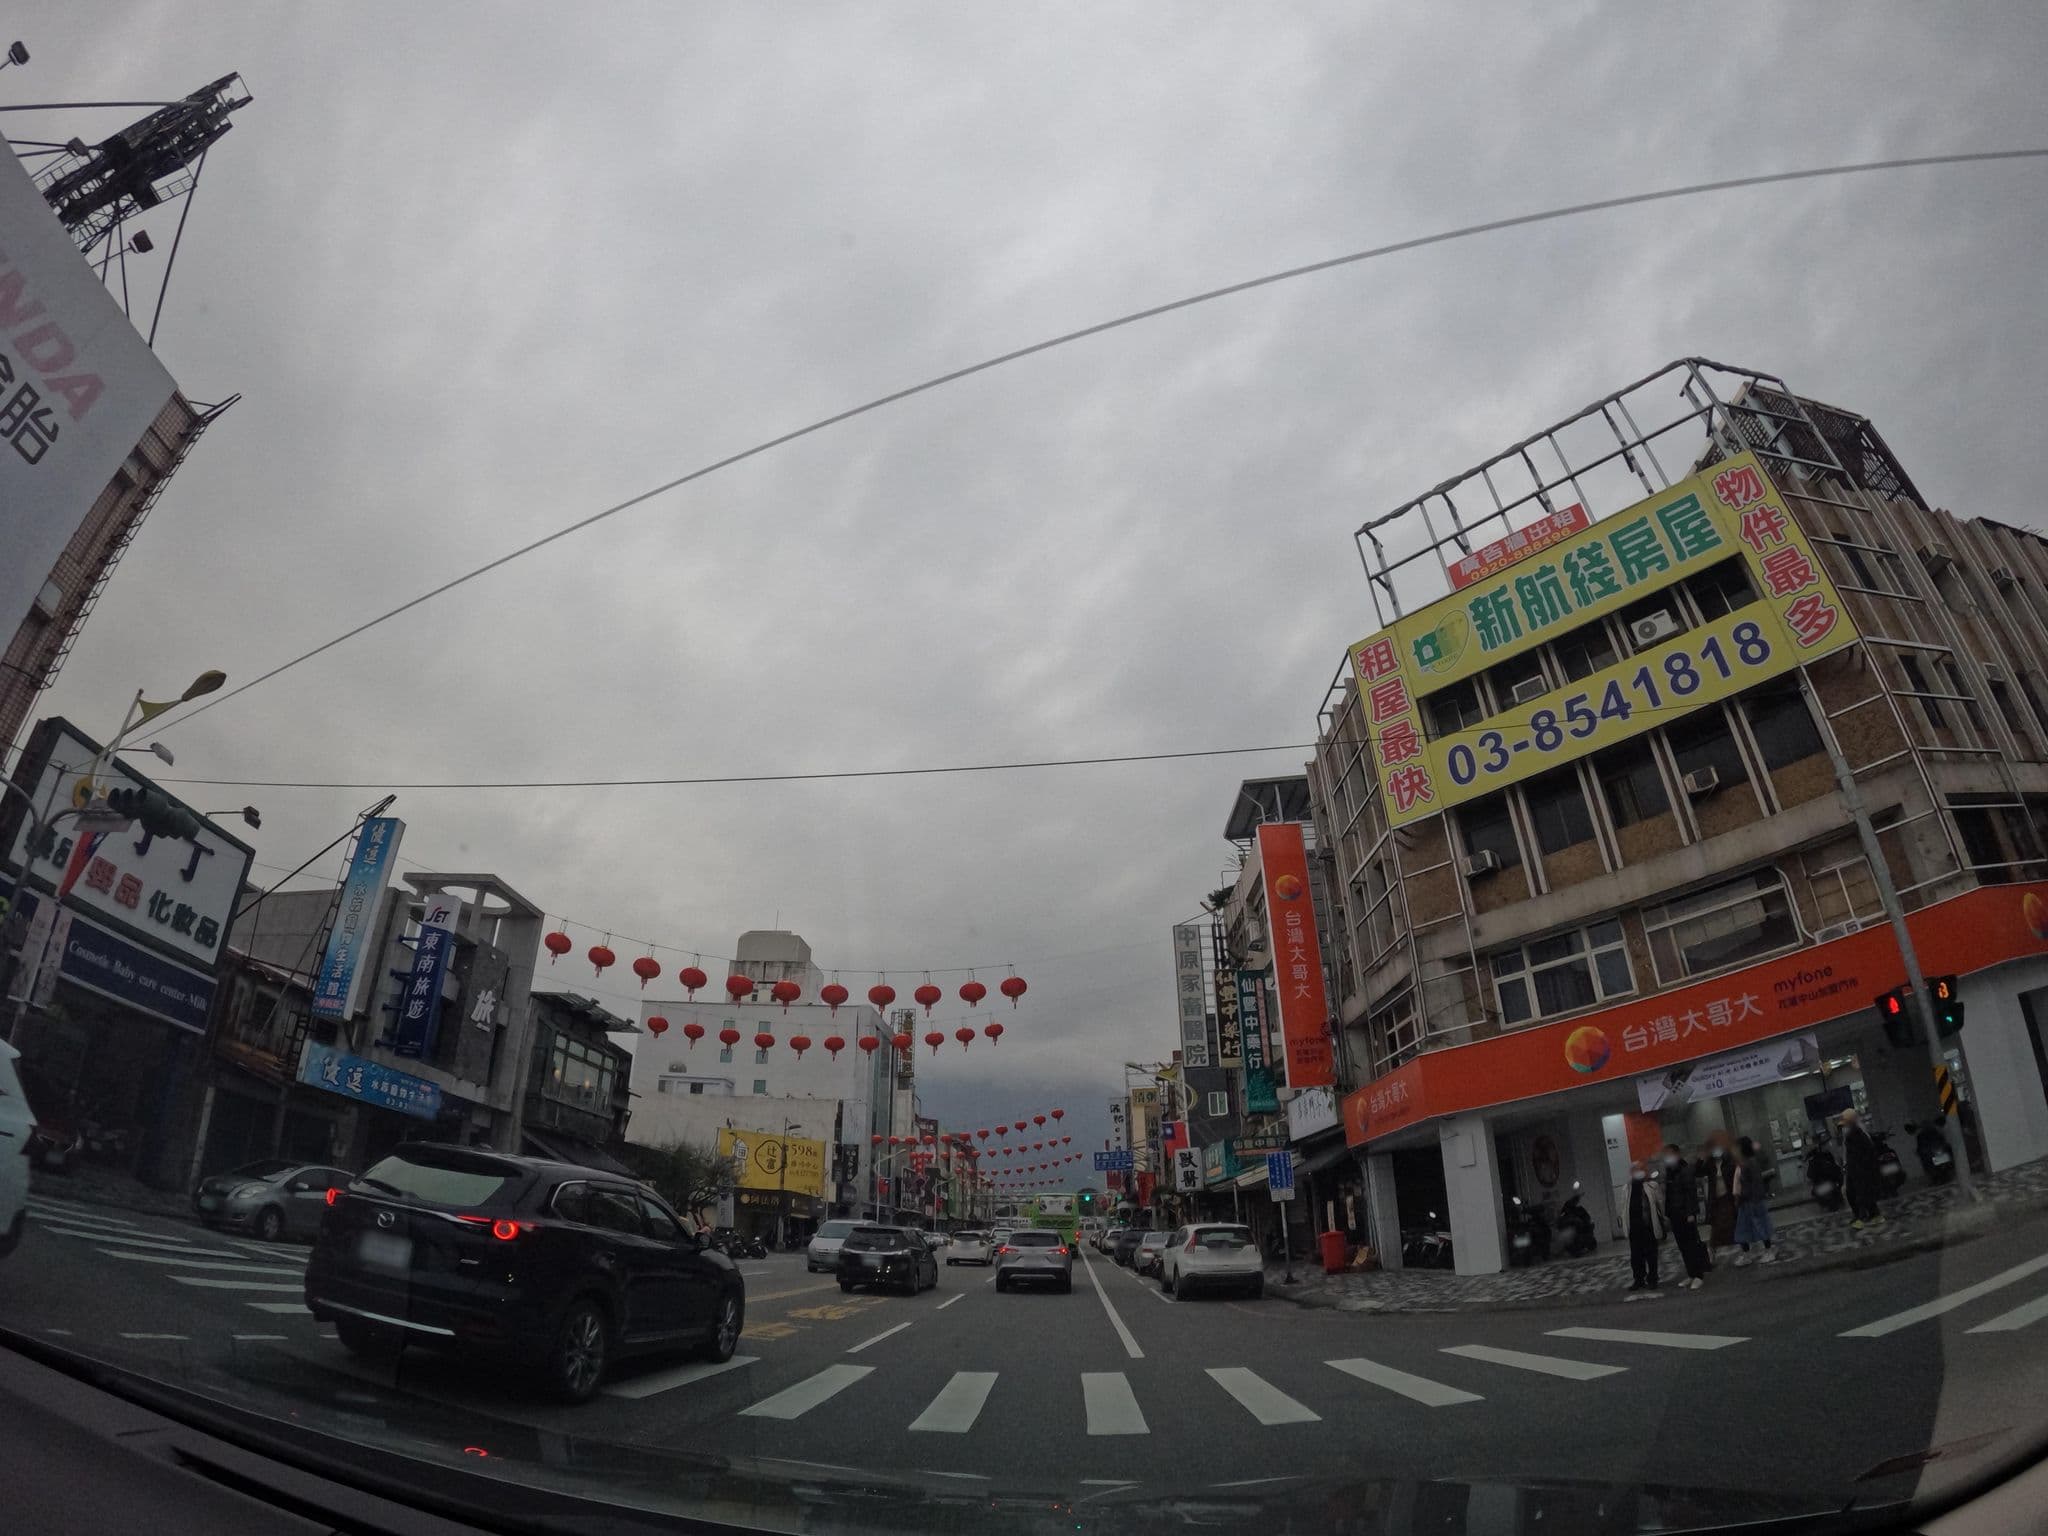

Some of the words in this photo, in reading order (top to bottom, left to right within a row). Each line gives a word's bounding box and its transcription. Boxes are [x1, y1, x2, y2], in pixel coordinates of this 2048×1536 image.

[1460, 509, 1577, 577] 廣告牆出租
[1714, 463, 1840, 647] 物件最多
[1355, 637, 1436, 813] 租屋最快
[1447, 620, 1773, 786] 03-8541818
[406, 932, 442, 1019] 東南旅遊
[1178, 926, 1208, 1066] 中原家畜醫院
[1284, 910, 1312, 999] 台灣大哥大
[1773, 965, 1834, 993] myfone
[470, 990, 497, 1025] 旅
[1622, 992, 1764, 1053] 台灣大哥大
[1179, 1151, 1199, 1188] 獸醫
